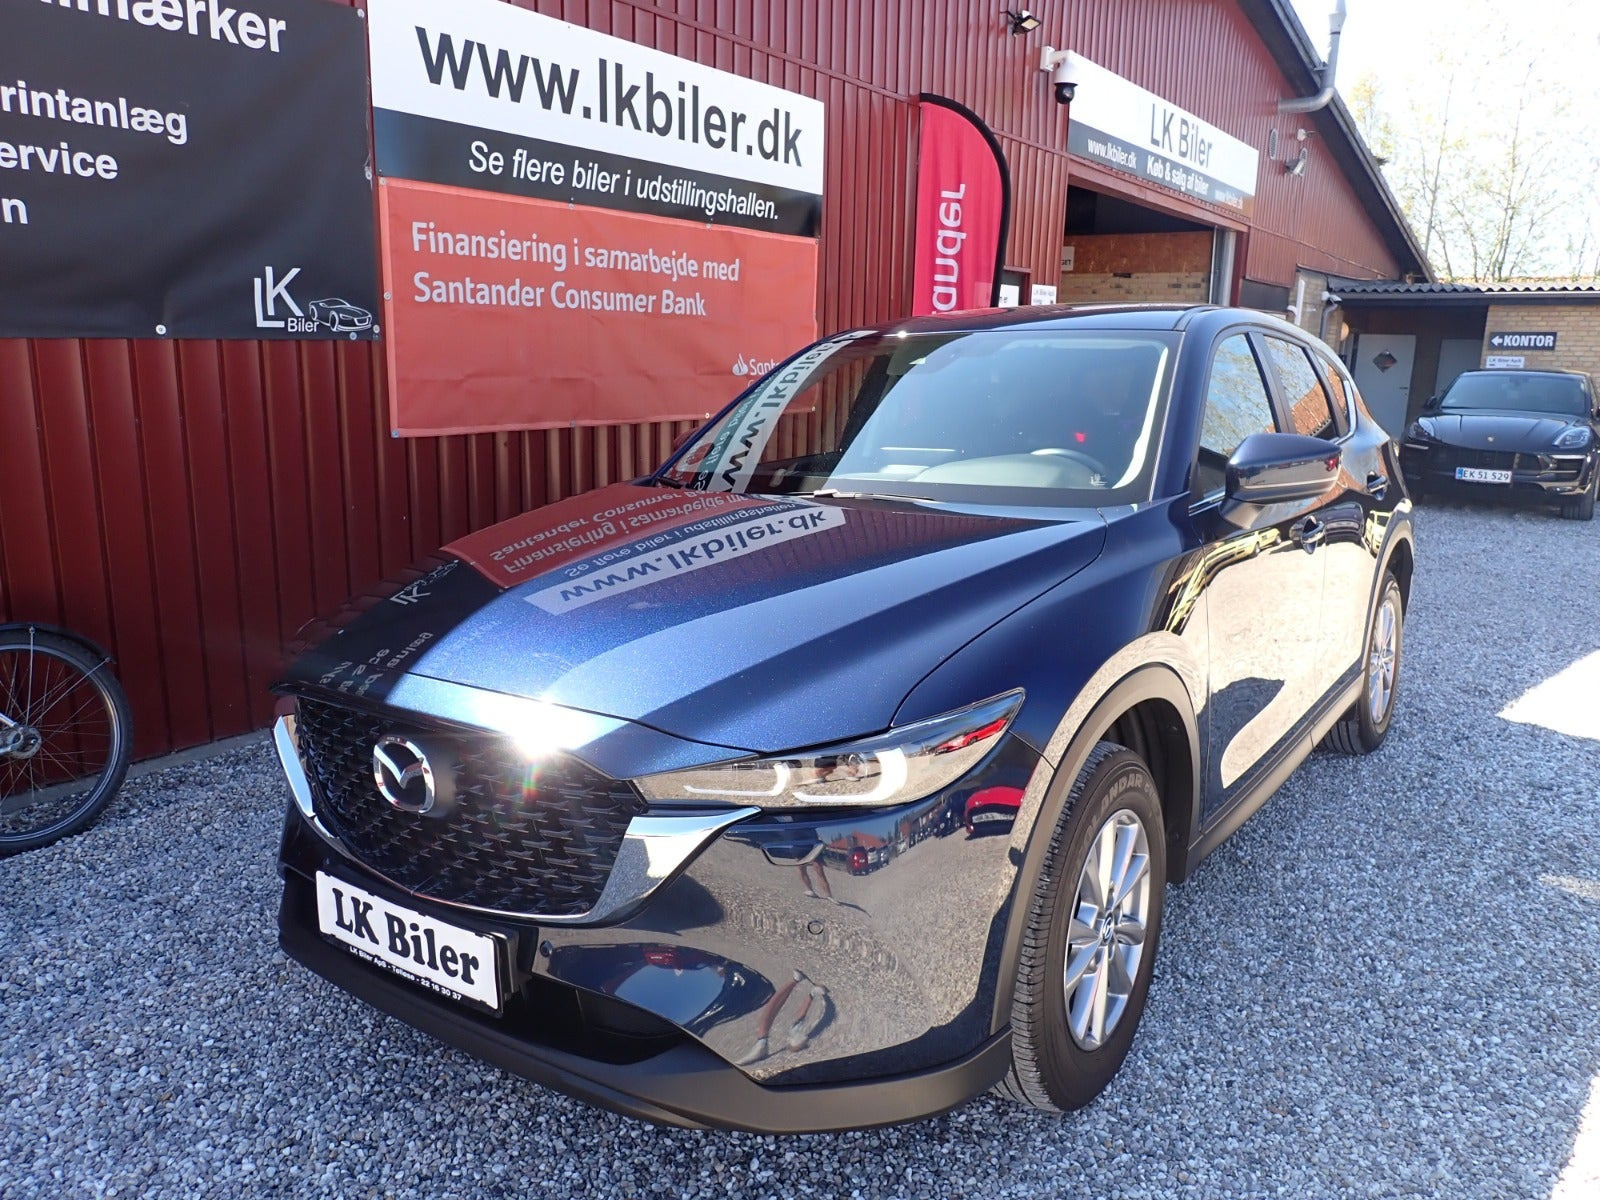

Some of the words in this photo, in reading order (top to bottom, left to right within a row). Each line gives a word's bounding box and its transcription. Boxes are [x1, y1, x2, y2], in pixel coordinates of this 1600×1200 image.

[0, 79, 188, 145] rintanlæg
[414, 25, 803, 168] www.lkbiler.dk
[1150, 103, 1175, 153] LK
[1178, 118, 1213, 169] Biler
[468, 140, 505, 176] Se
[512, 148, 565, 186] flere
[572, 159, 621, 194] biler
[624, 169, 632, 197] i
[636, 175, 779, 221] udstillingshallen.
[411, 221, 568, 273] Finansiering
[573, 237, 580, 266] i
[584, 248, 699, 283] samarbejde
[702, 258, 741, 282] med
[253, 265, 305, 328] LK
[287, 316, 320, 333] Biler
[413, 271, 545, 308] Santander
[550, 281, 657, 314] Consumer
[661, 289, 707, 316] Bank
[1503, 334, 1554, 348] KONTOR
[1463, 469, 1476, 478] EK
[1478, 471, 1488, 480] 51
[331, 887, 380, 945] LK
[384, 911, 480, 985] Biler
[421, 978, 431, 988] 22
